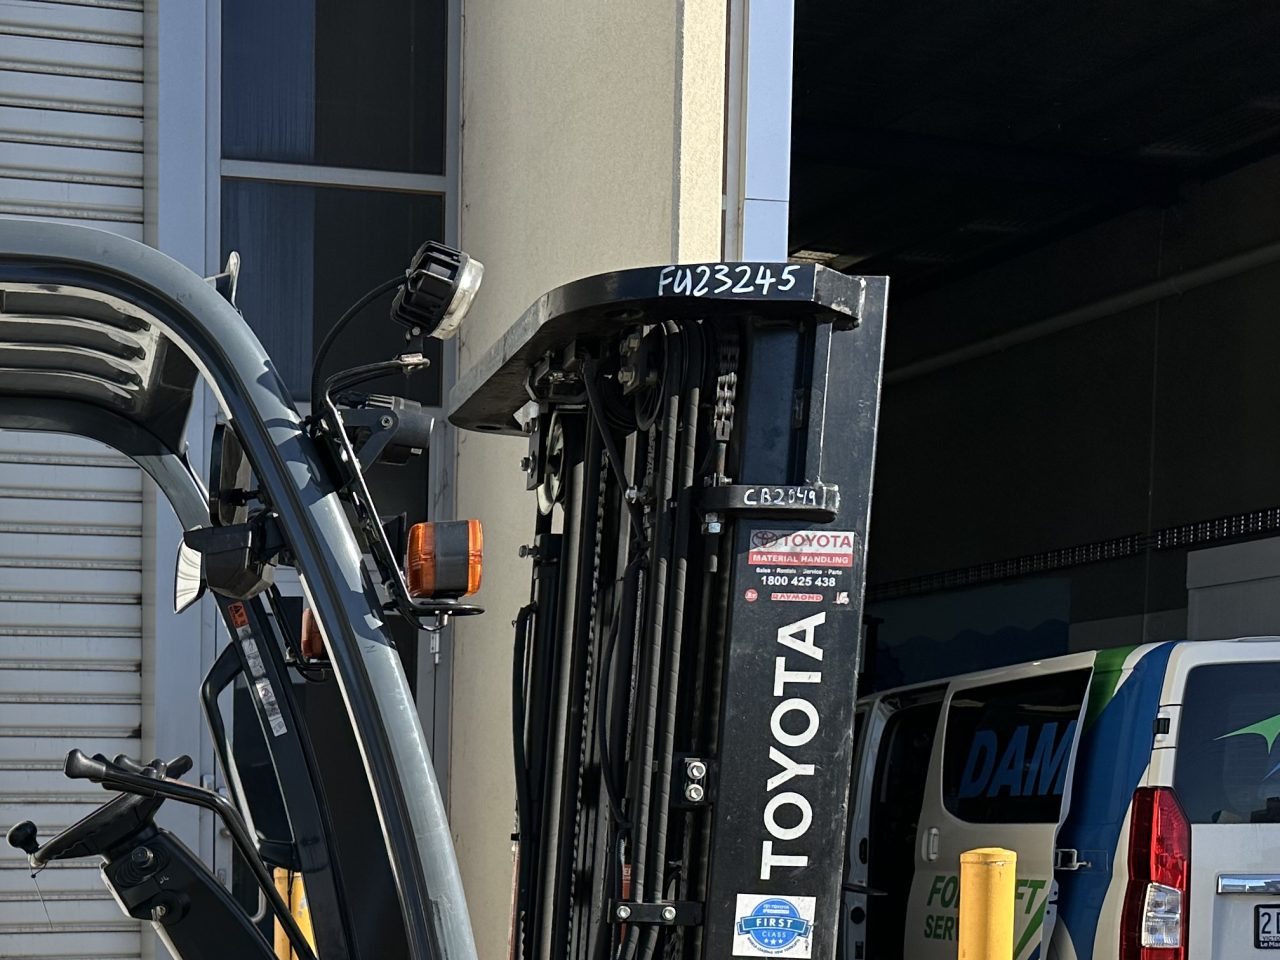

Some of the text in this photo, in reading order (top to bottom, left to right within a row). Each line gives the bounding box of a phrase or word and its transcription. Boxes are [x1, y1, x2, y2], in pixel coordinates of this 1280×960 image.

[657, 264, 801, 297] FU23245
[783, 534, 852, 548] TOYOTA
[752, 554, 848, 564] MATERIAL HANDLING
[761, 576, 836, 587] 1800 425 438
[771, 593, 822, 602] RAYMOND
[760, 611, 826, 880] TOYOTA
[756, 918, 793, 928] FIRST
